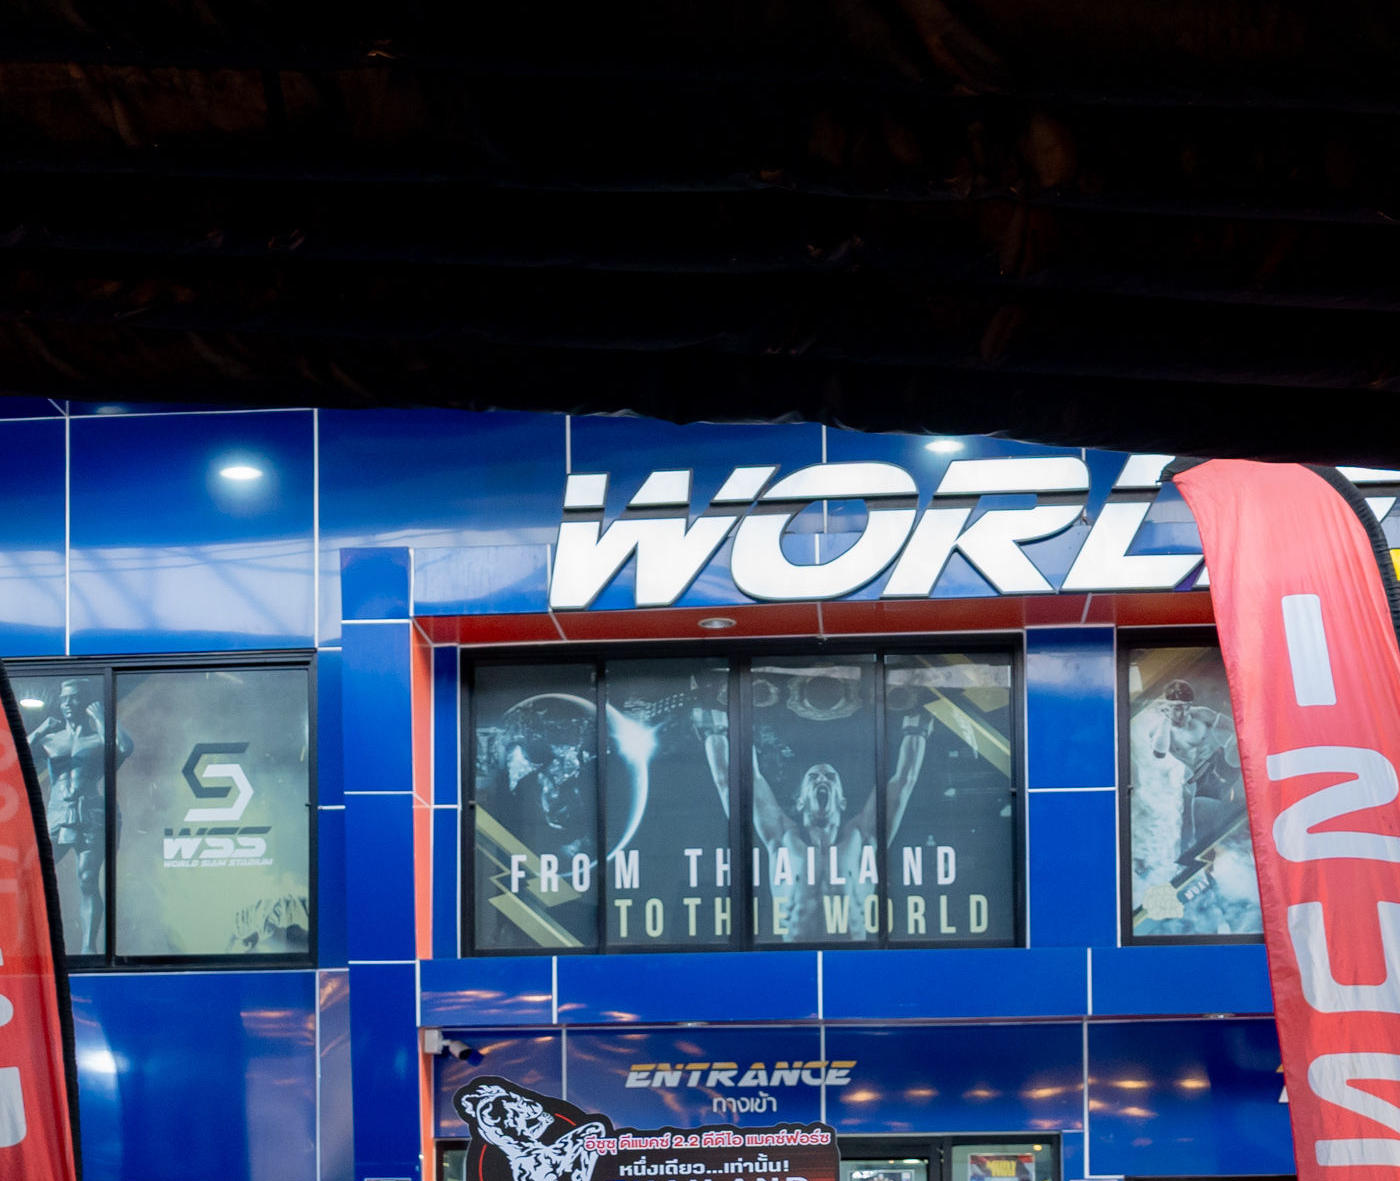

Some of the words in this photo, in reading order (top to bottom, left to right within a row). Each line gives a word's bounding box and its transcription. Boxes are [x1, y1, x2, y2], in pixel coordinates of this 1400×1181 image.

[548, 454, 1400, 610] WORL
[163, 826, 272, 859] WSS
[510, 849, 640, 893] FROM
[685, 845, 957, 887] THAILAND
[614, 898, 665, 938] TO
[823, 893, 989, 935] WORLD
[625, 1060, 857, 1088] ENTRANCE
[712, 1090, 777, 1113] ทางเข้า
[673, 1133, 699, 1149] 2.2
